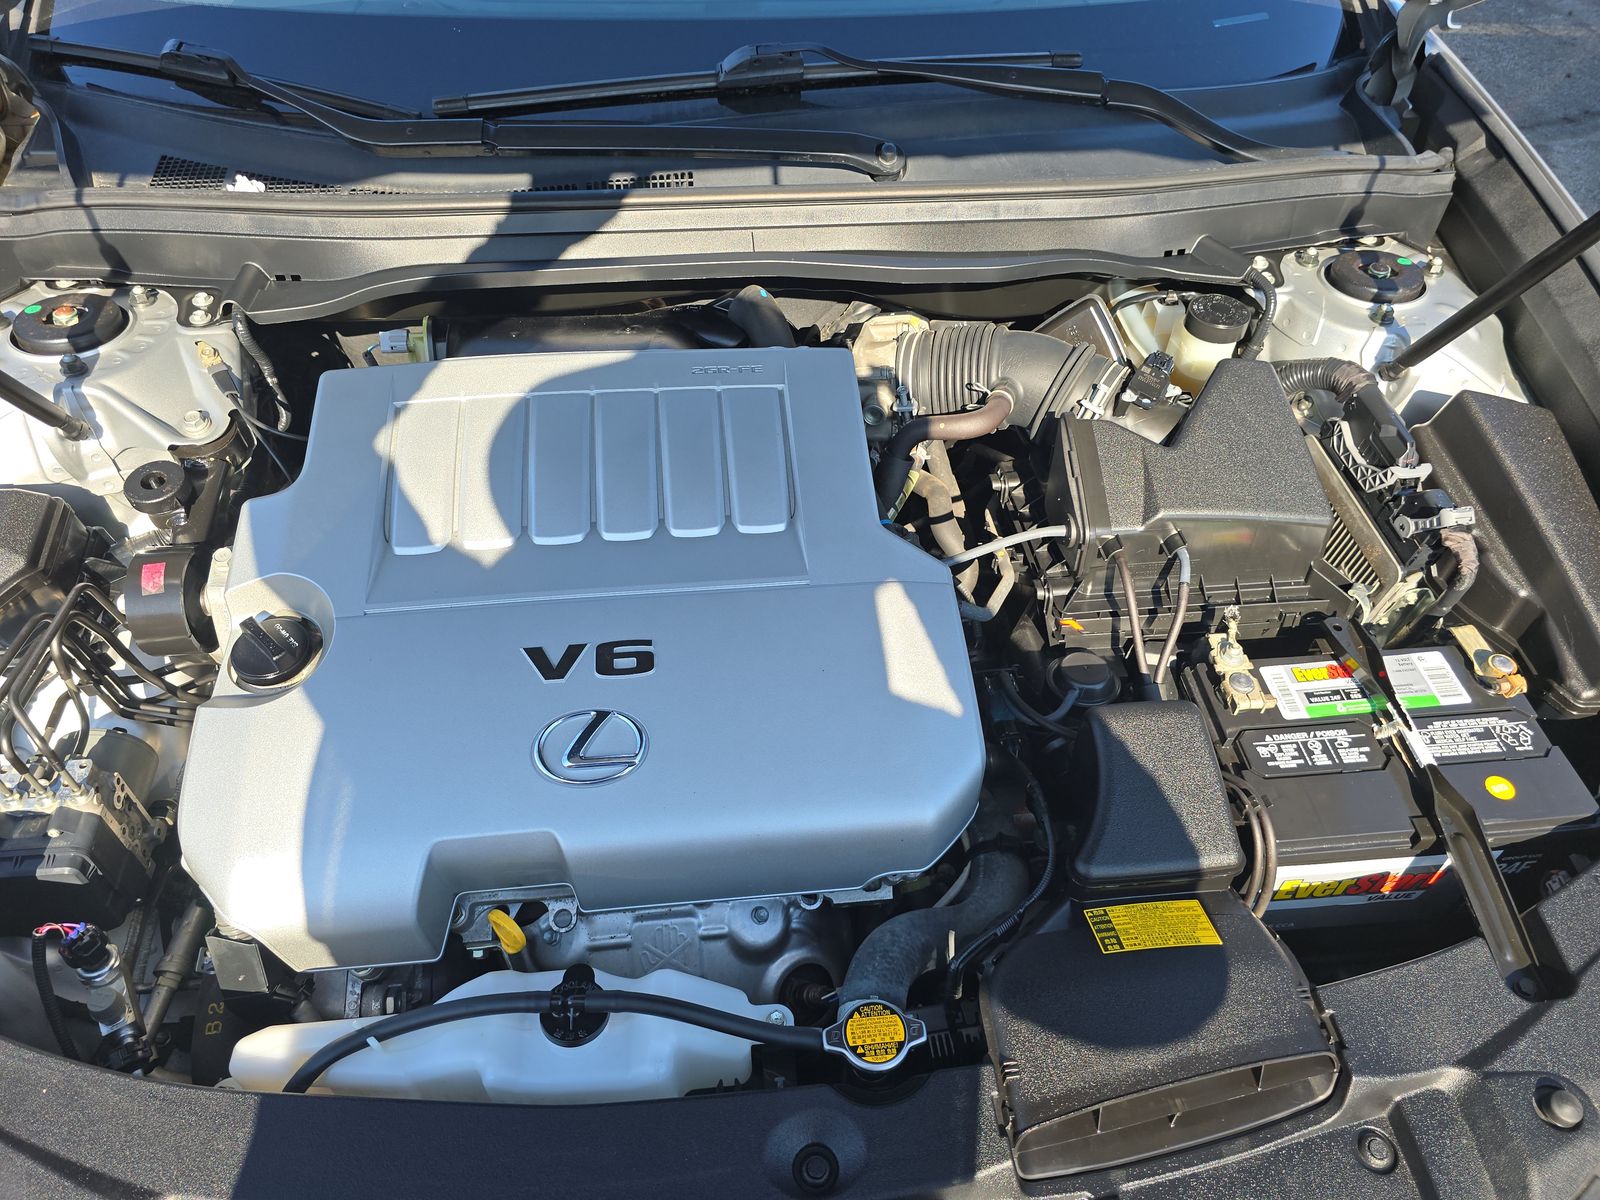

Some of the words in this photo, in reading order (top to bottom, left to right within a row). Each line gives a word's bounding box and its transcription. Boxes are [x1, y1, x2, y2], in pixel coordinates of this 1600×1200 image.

[691, 364, 764, 375] 2GR-FE
[521, 639, 655, 682] V6
[1272, 732, 1309, 741] DANGER
[1315, 729, 1348, 738] POISON
[1273, 870, 1448, 900] EverStart
[1367, 891, 1418, 902] VALUE
[859, 1004, 883, 1013] CAUTION
[861, 1009, 891, 1018] ATTENTION
